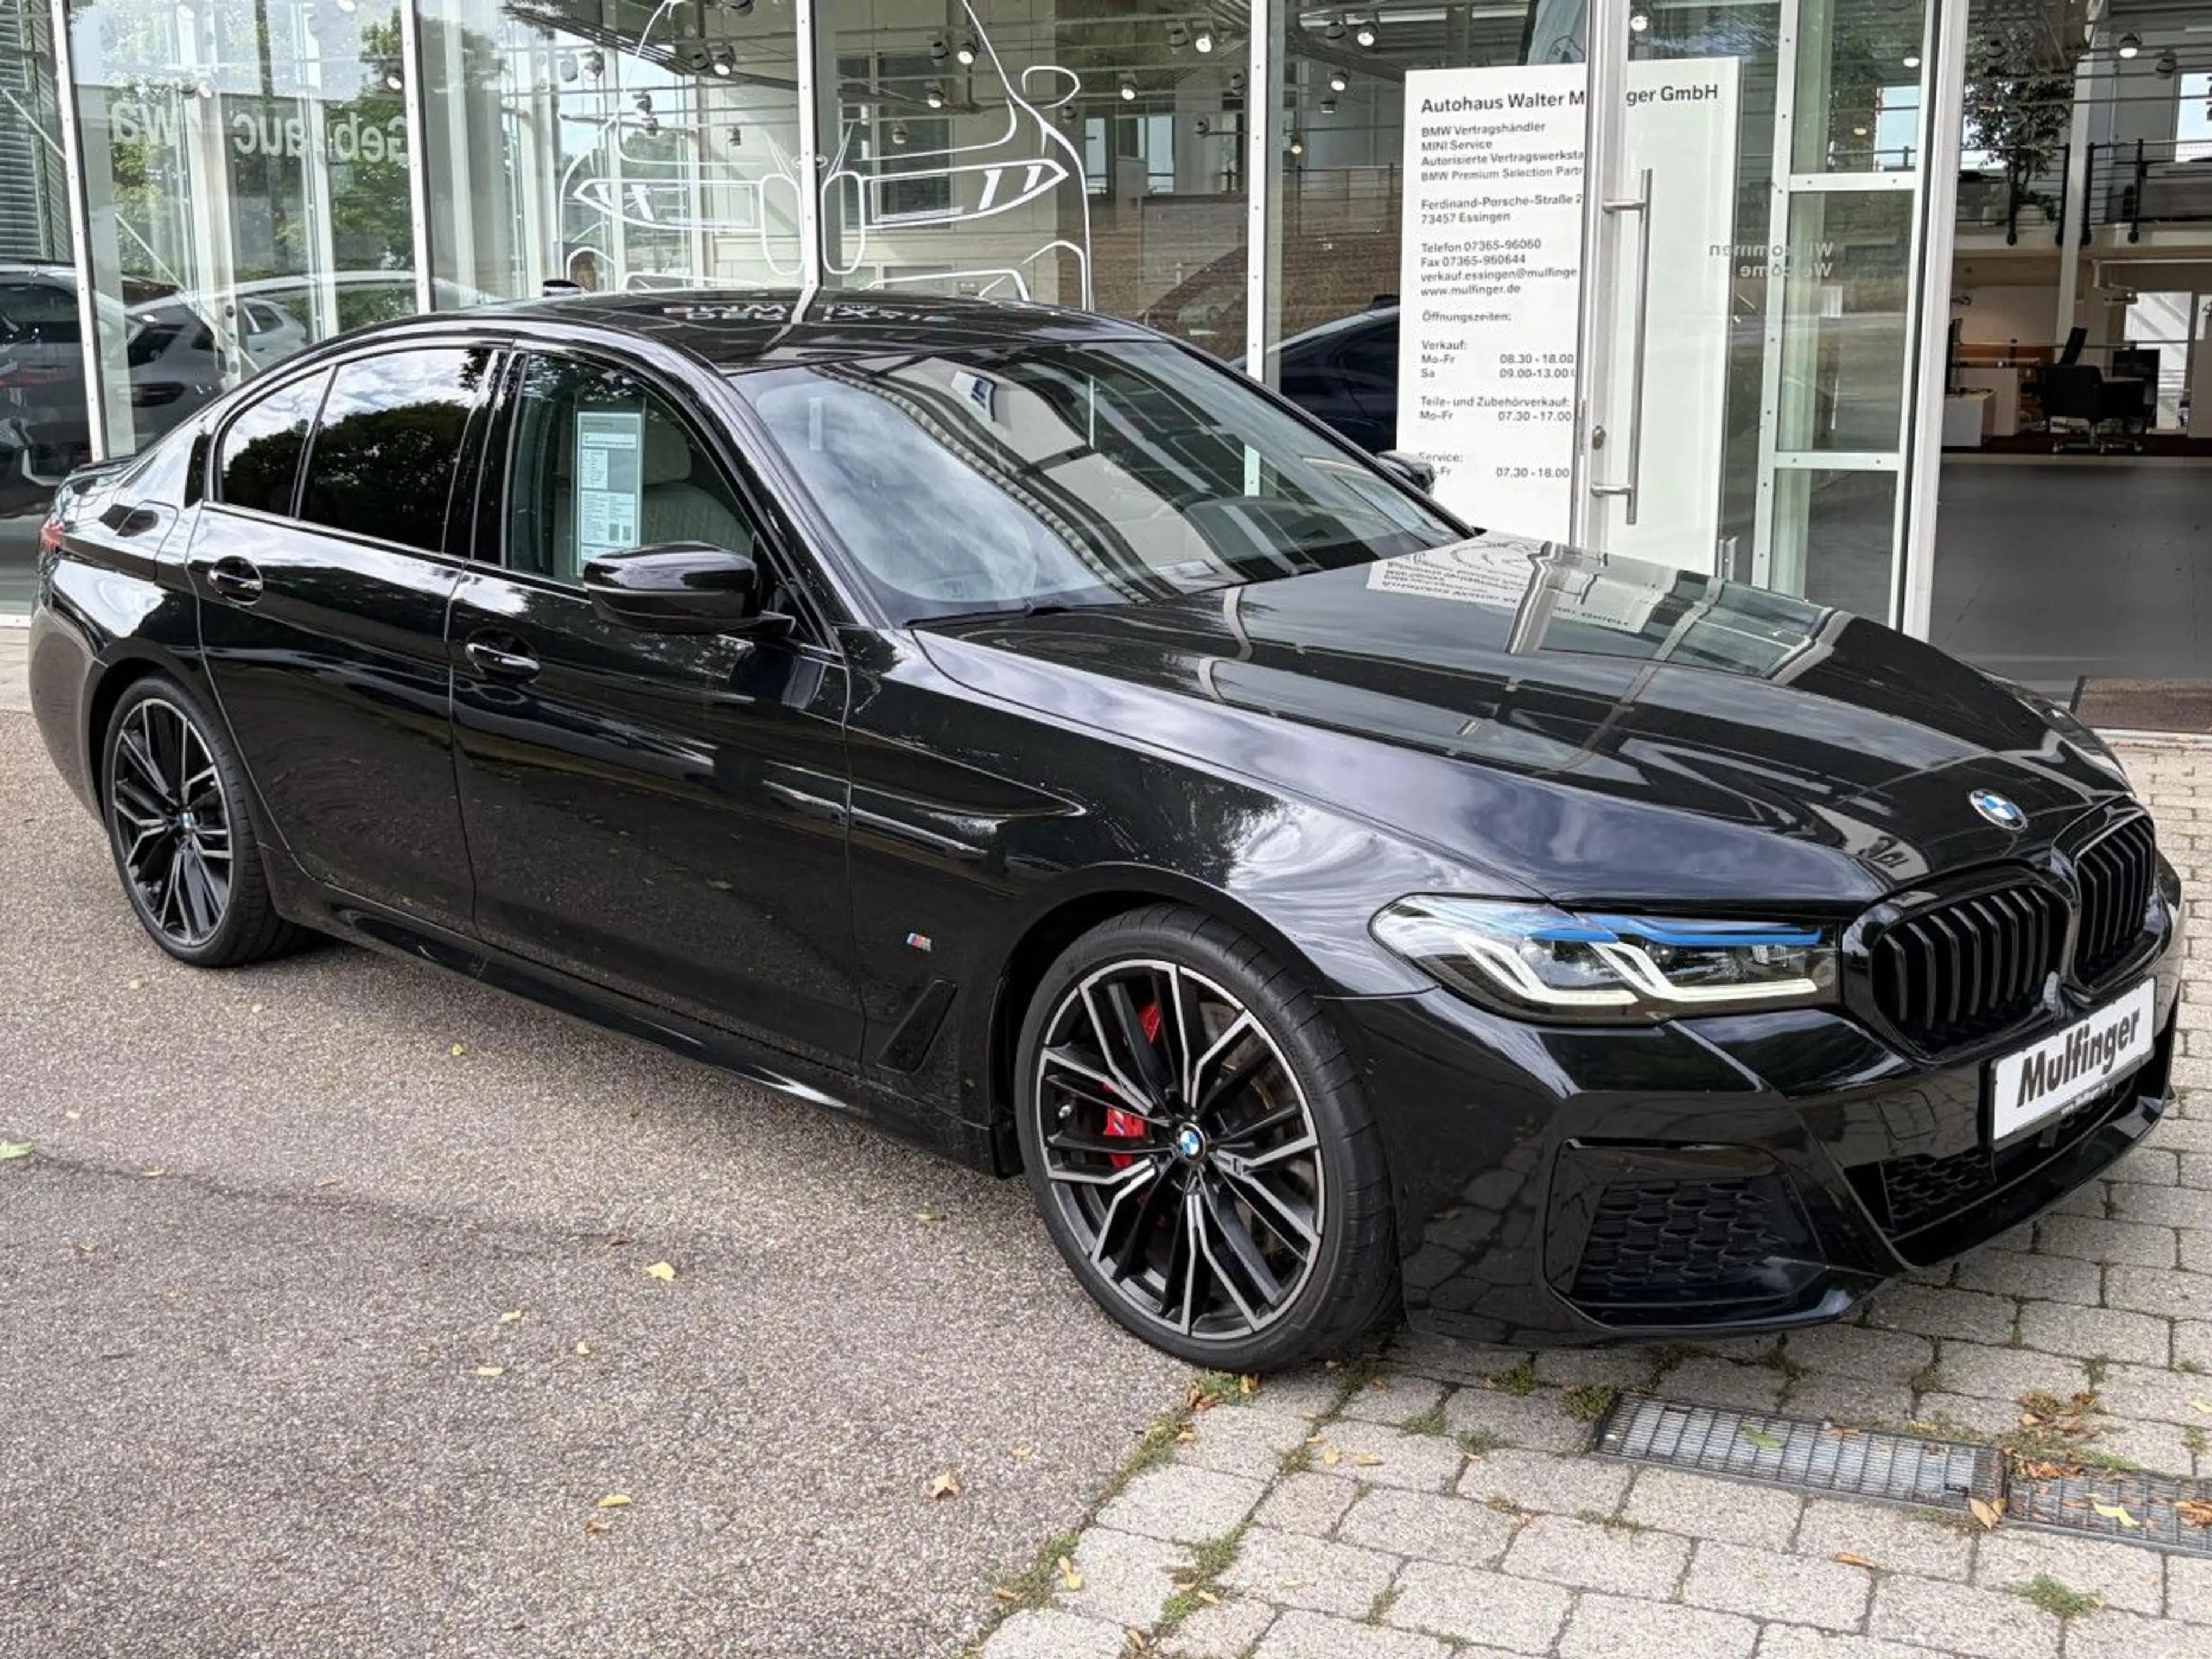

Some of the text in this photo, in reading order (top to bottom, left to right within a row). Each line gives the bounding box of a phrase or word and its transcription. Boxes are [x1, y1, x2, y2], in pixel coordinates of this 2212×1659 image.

[1421, 96, 1503, 113] Autohaus
[1508, 92, 1564, 108] Walter
[1661, 84, 1718, 101] GmbH
[1422, 122, 1546, 137] BMW Vertragshändler
[1421, 140, 1493, 151] MINI Service
[1421, 155, 1487, 167] Autorisierte
[1421, 171, 1448, 182] BMW
[1452, 170, 1499, 180] Premium
[1502, 167, 1552, 179] Selection
[1422, 211, 1511, 224] 73457 Essingen
[1422, 238, 1541, 253] Telefon 07365-96060
[1421, 254, 1526, 267] Fax 07365-960644
[1421, 284, 1521, 297] www.mulfinger.de
[1422, 310, 1512, 324] Öffnungszeiten:
[1422, 340, 1467, 350] Verkauf:
[1421, 354, 1455, 364] Mo-Fr
[1499, 354, 1532, 364] 08.30
[1543, 354, 1574, 364] 18.00
[1421, 368, 1435, 378] Sa
[1421, 396, 1451, 407] Teile-
[1453, 397, 1474, 407] und
[1420, 411, 1453, 421] Mo-Fr
[1498, 411, 1530, 421] 07.30
[1541, 411, 1571, 421] 17.00
[1418, 452, 1463, 463] Service:
[1497, 467, 1528, 478] 07.30
[1539, 467, 1570, 478] 18.00
[2017, 1007, 2140, 1108] Mulfinger
